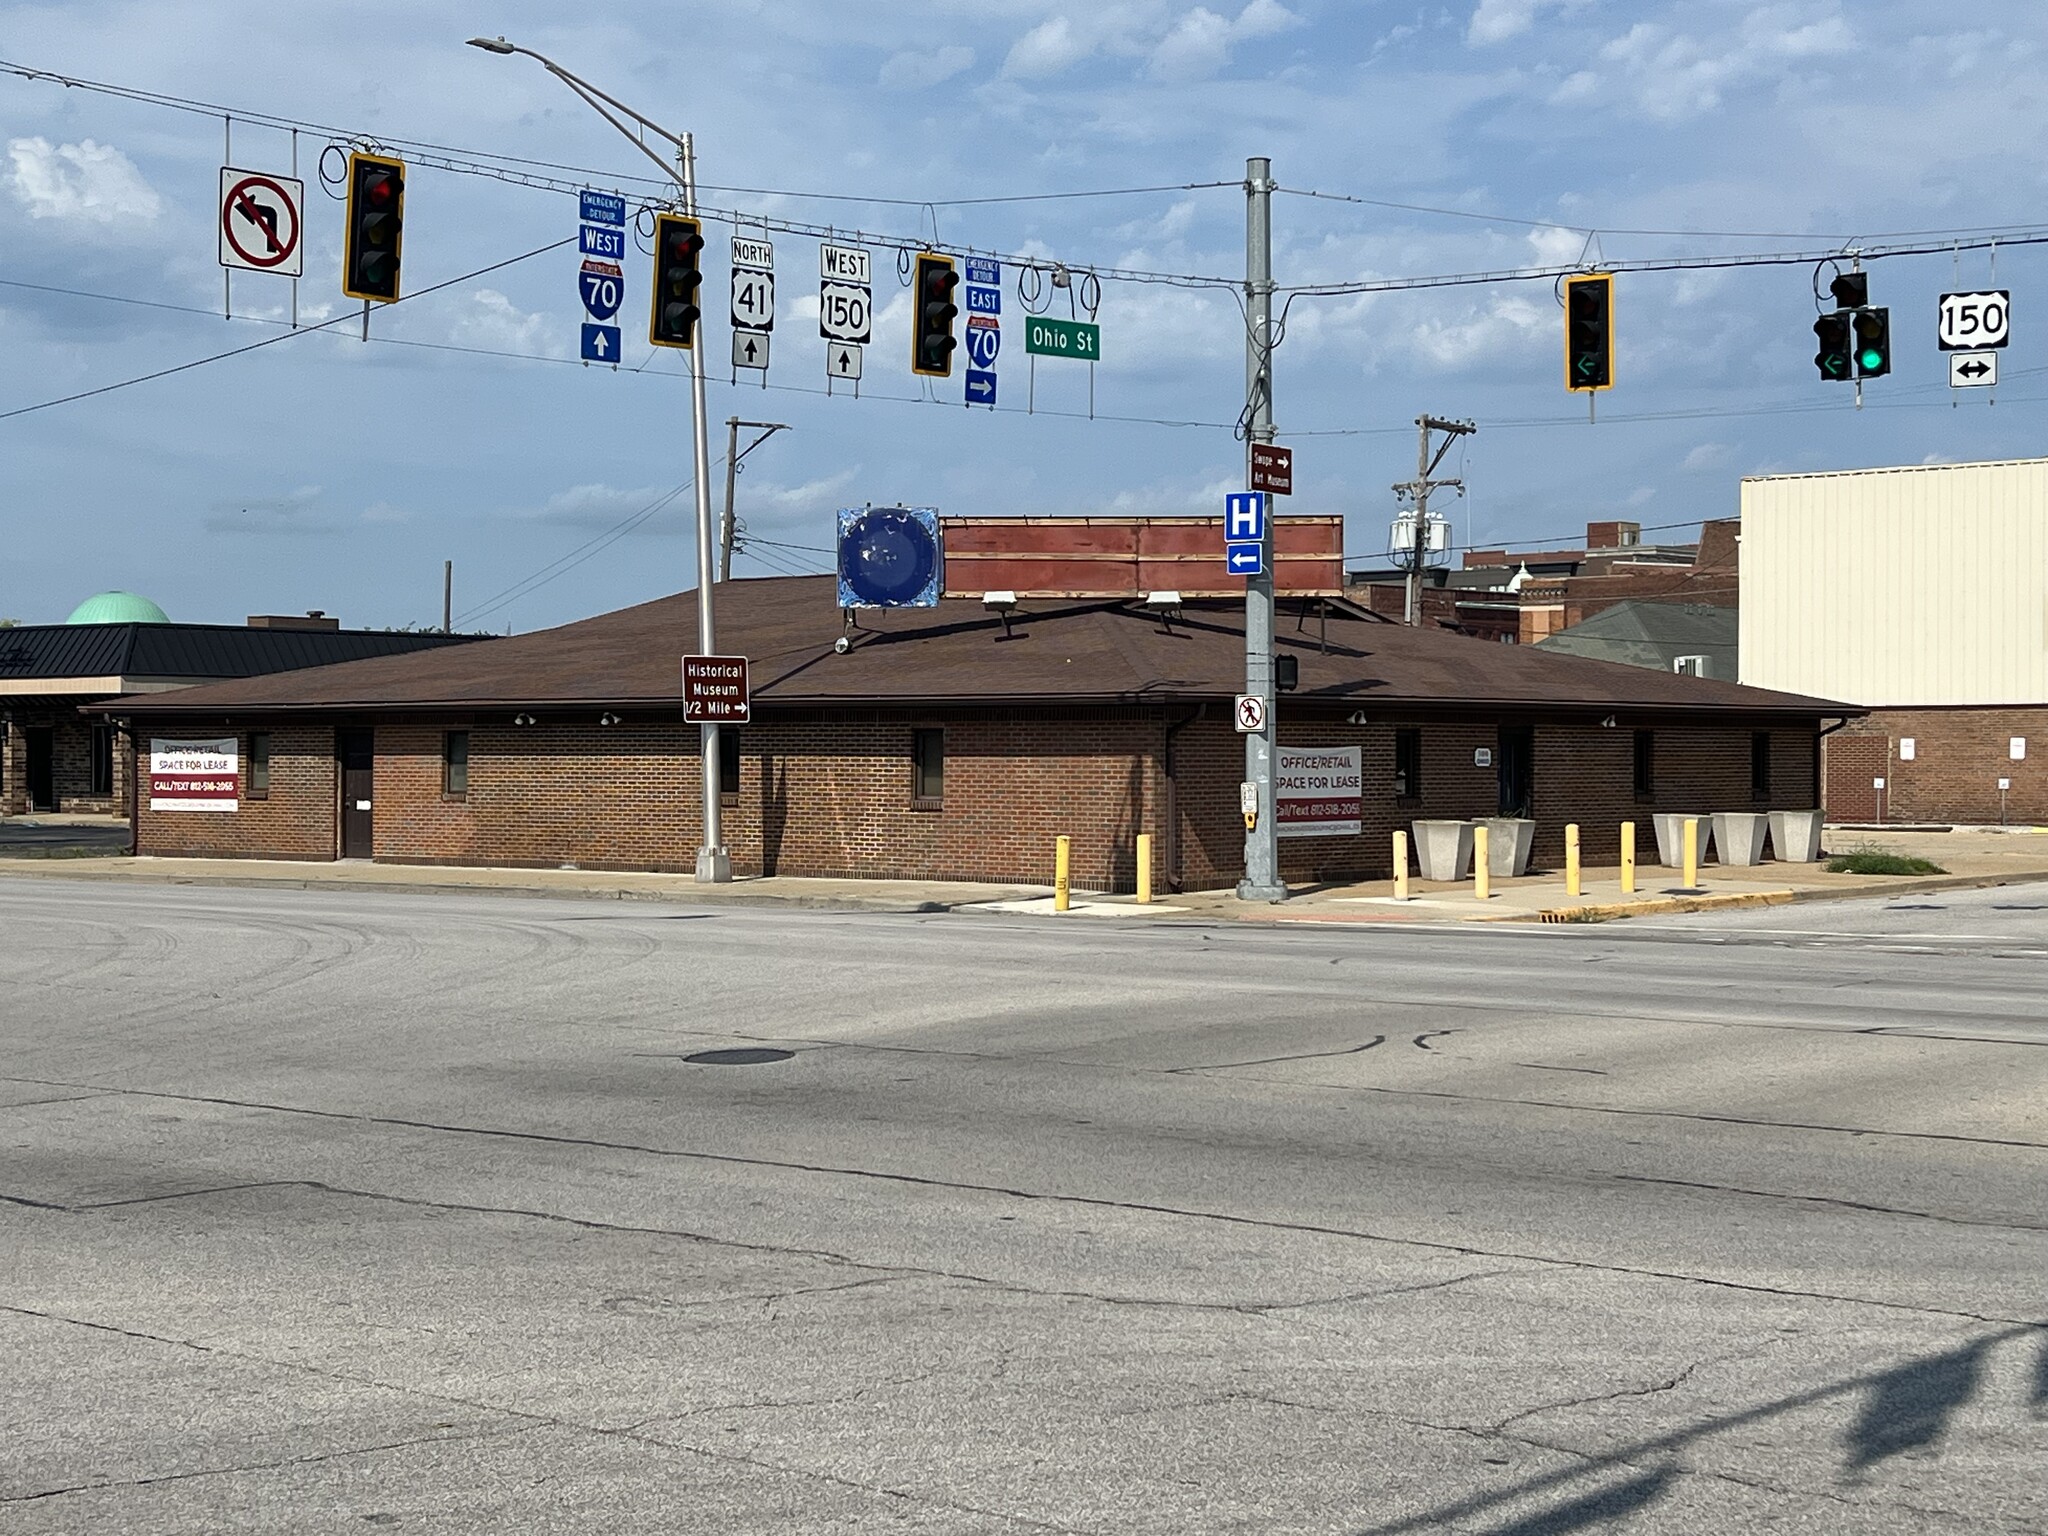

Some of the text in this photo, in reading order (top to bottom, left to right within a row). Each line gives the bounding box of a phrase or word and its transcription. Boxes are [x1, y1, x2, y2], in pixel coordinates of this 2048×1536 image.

[582, 193, 622, 210] EMERGENCY
[589, 207, 616, 222] DETOUR
[585, 228, 620, 255] WEST
[733, 240, 771, 264] NORTH
[825, 247, 866, 277] WEST
[967, 258, 999, 272] EMERGENCY
[972, 269, 994, 282] DETOUR
[586, 276, 617, 308] 70
[738, 282, 765, 315] 41
[971, 290, 997, 310] EAST
[827, 294, 864, 330] 150
[1946, 303, 2003, 336] 150
[969, 328, 997, 360] 70
[1033, 326, 1093, 352] Ohio St
[1253, 471, 1264, 484] Art
[1231, 497, 1257, 535] H
[687, 663, 742, 678] Historical
[693, 682, 739, 696] Museum
[685, 700, 731, 715] 1/2 Mile
[159, 760, 228, 770] SPACE FOR LEASE
[1280, 755, 1353, 770] OFFICE/RETAIL
[153, 780, 190, 792] CALL/TEXT
[1308, 776, 1328, 789] FOR
[1330, 775, 1360, 788] LEASE
